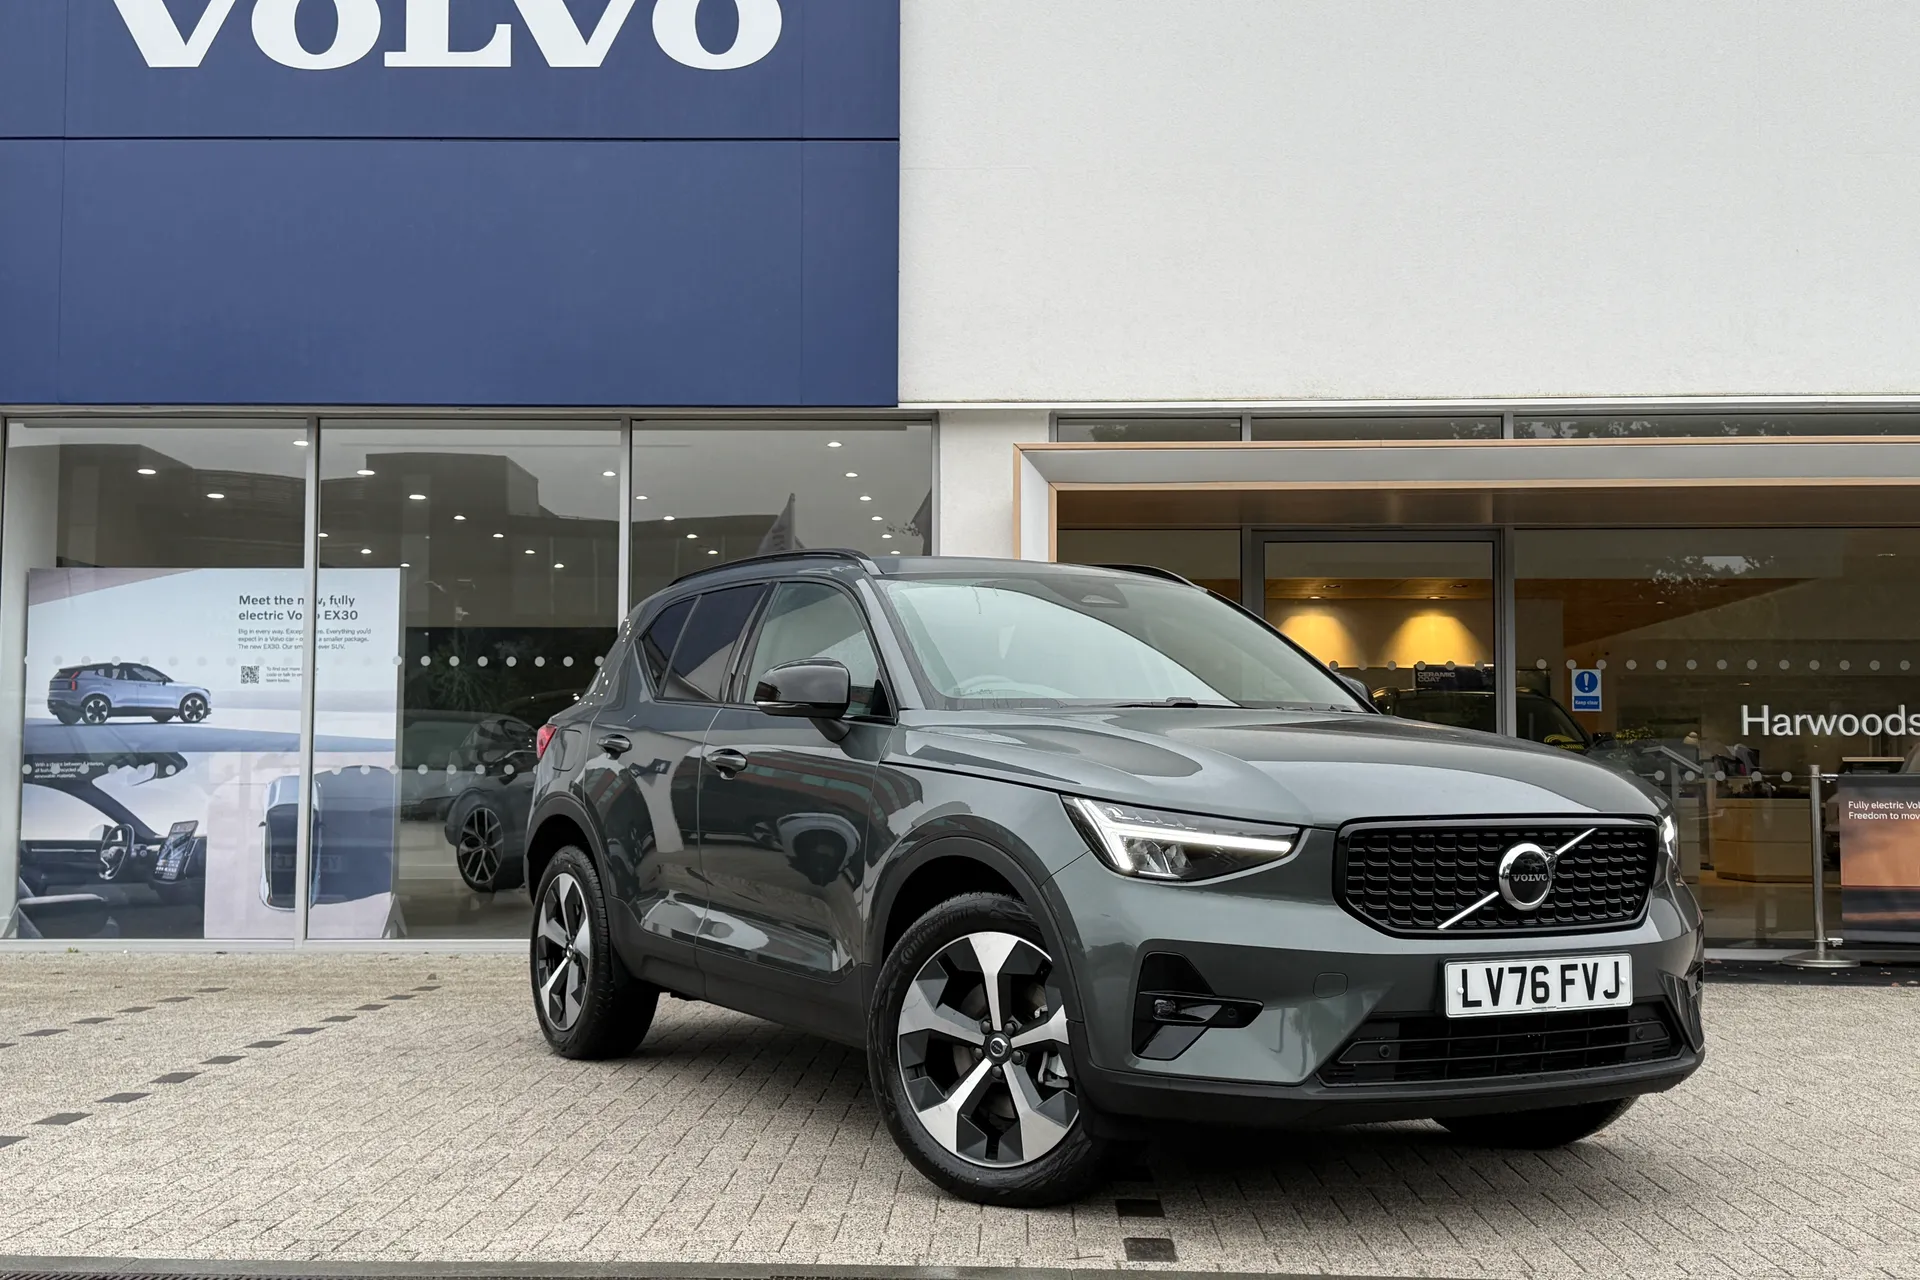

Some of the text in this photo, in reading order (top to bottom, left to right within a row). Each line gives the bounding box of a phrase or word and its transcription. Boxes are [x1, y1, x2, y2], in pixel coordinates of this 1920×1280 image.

[113, 0, 782, 70] VOLVO
[239, 595, 355, 607] Meet the nw, fully
[238, 610, 284, 620] electric
[324, 610, 358, 620] EX30
[1741, 704, 1920, 736] Harwoods
[1848, 801, 1920, 810] Fully electric Vol
[1848, 811, 1888, 820] Freedom
[1890, 812, 1899, 820] to
[1511, 873, 1548, 881] VOLVO
[1461, 961, 1620, 1008] LV76 FVJ
